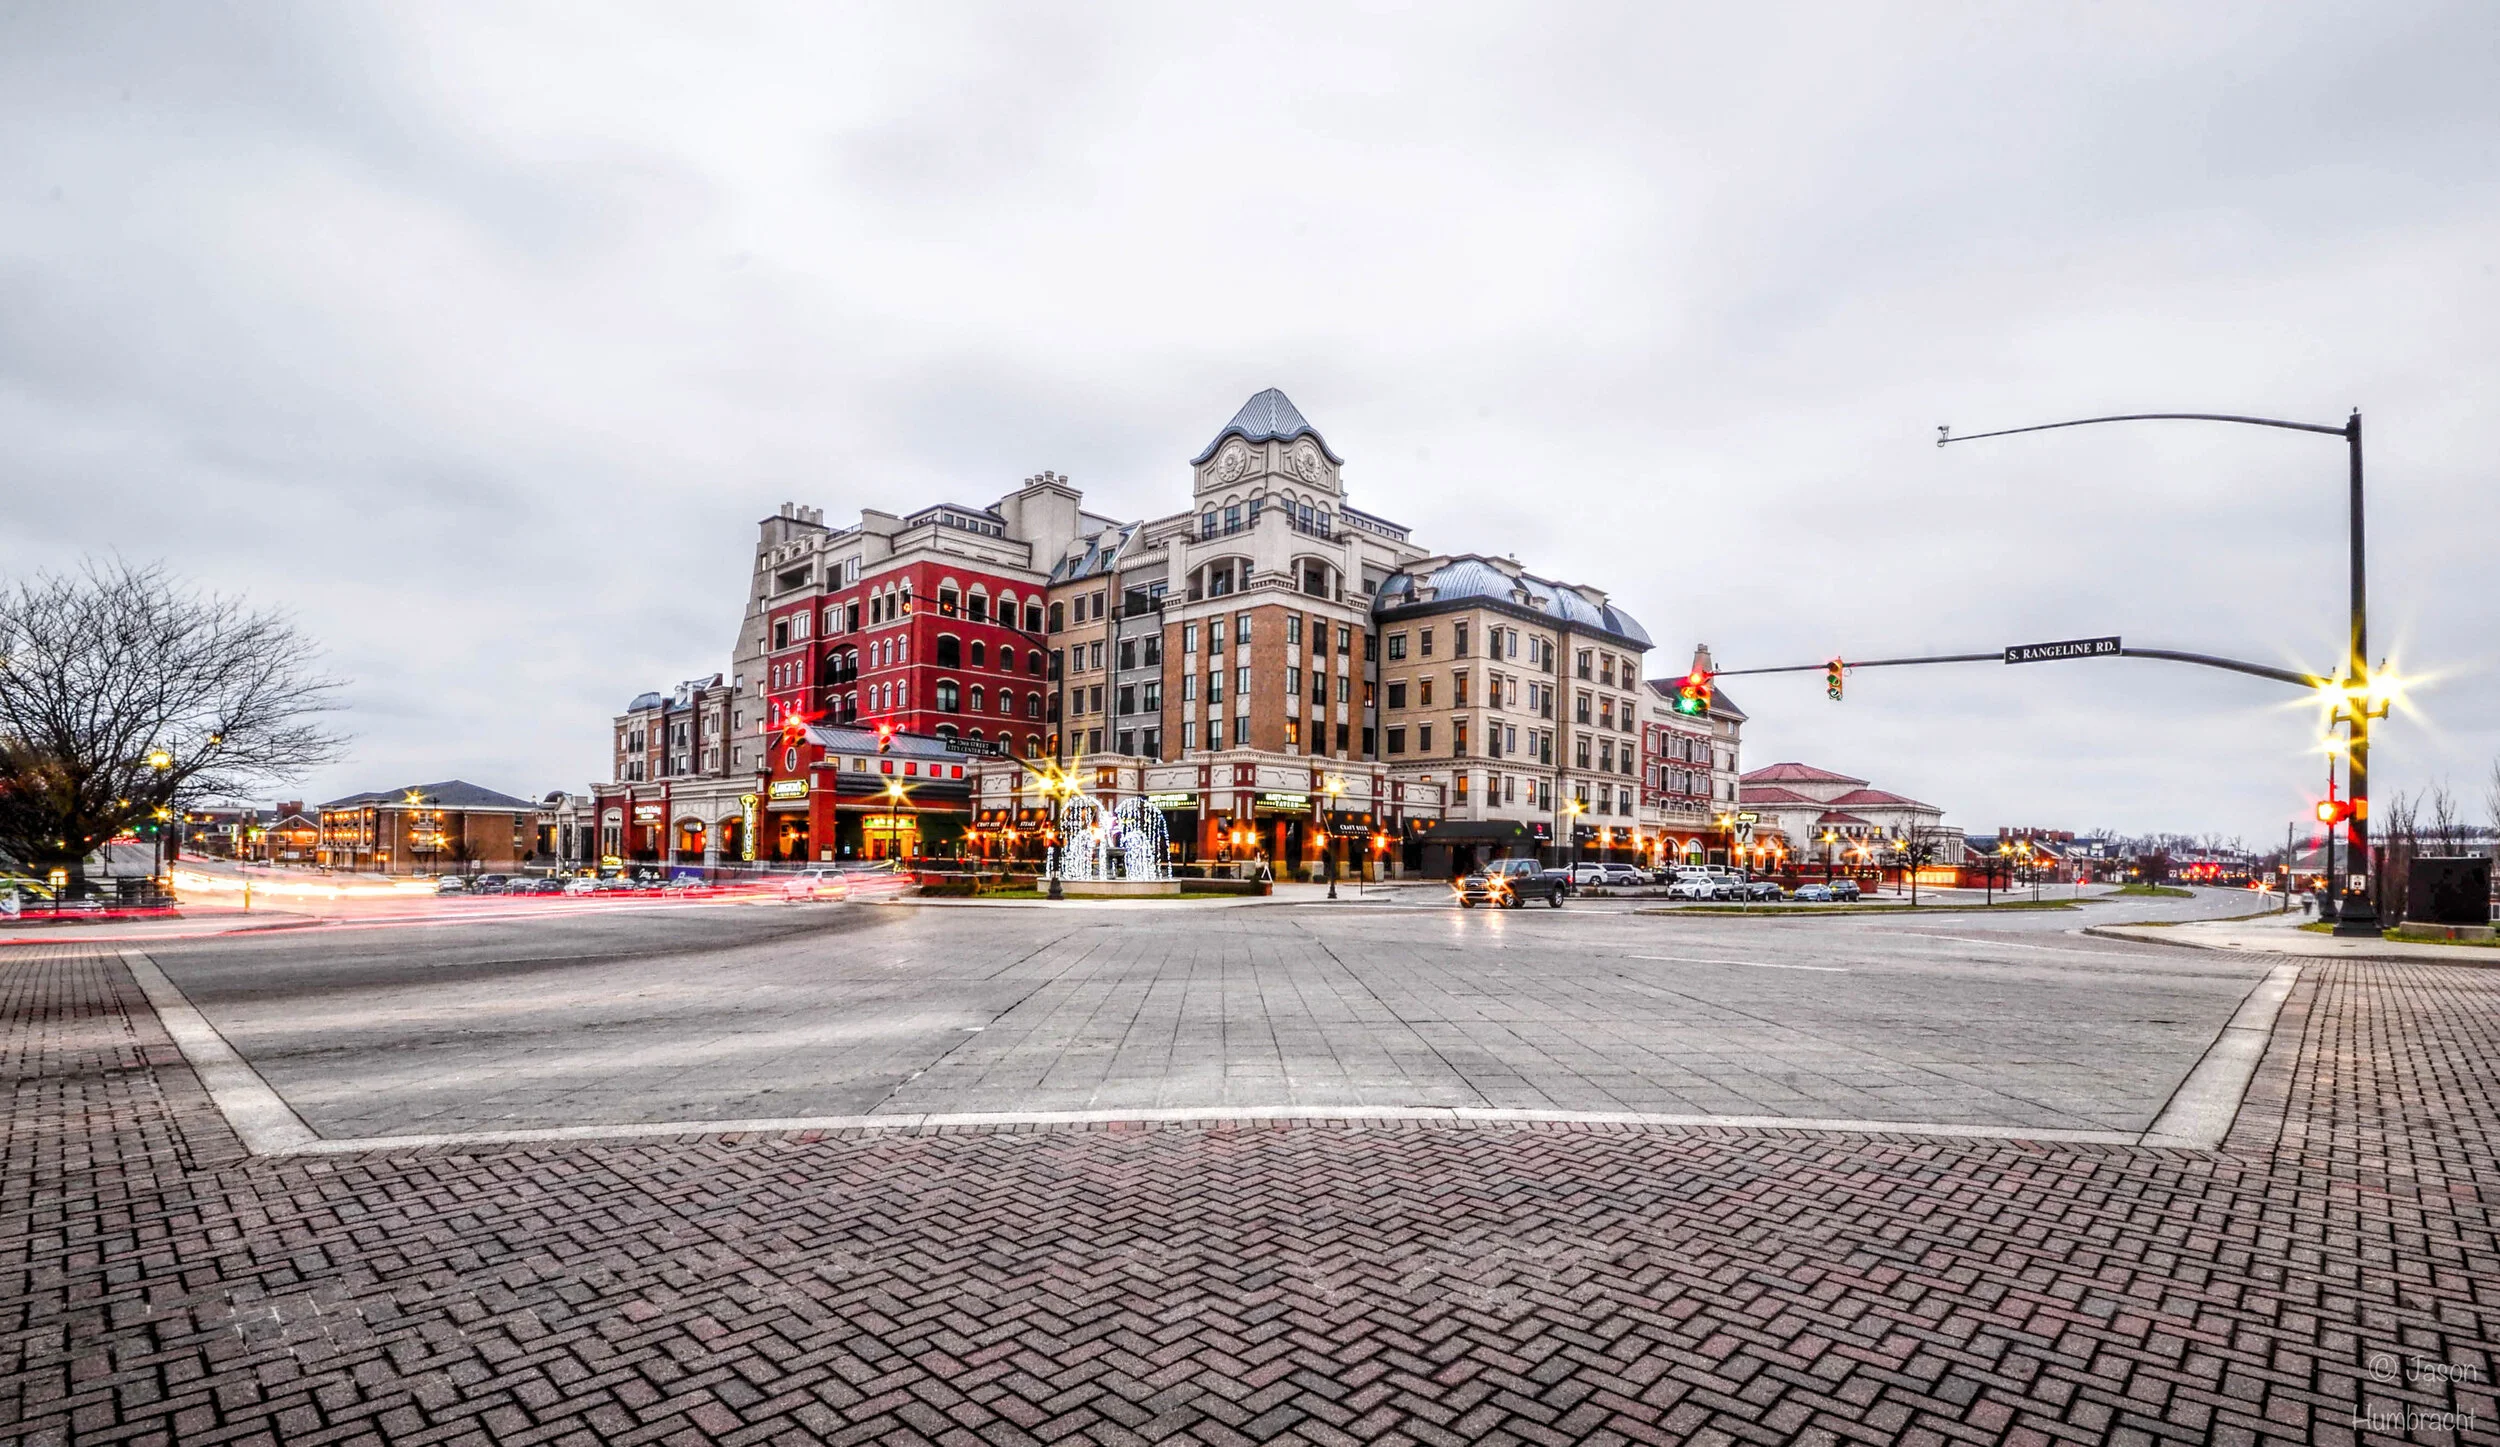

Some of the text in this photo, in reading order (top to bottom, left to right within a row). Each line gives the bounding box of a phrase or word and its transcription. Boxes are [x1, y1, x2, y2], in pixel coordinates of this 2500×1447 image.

[2008, 641, 2116, 661] S. RANGELINE RD.
